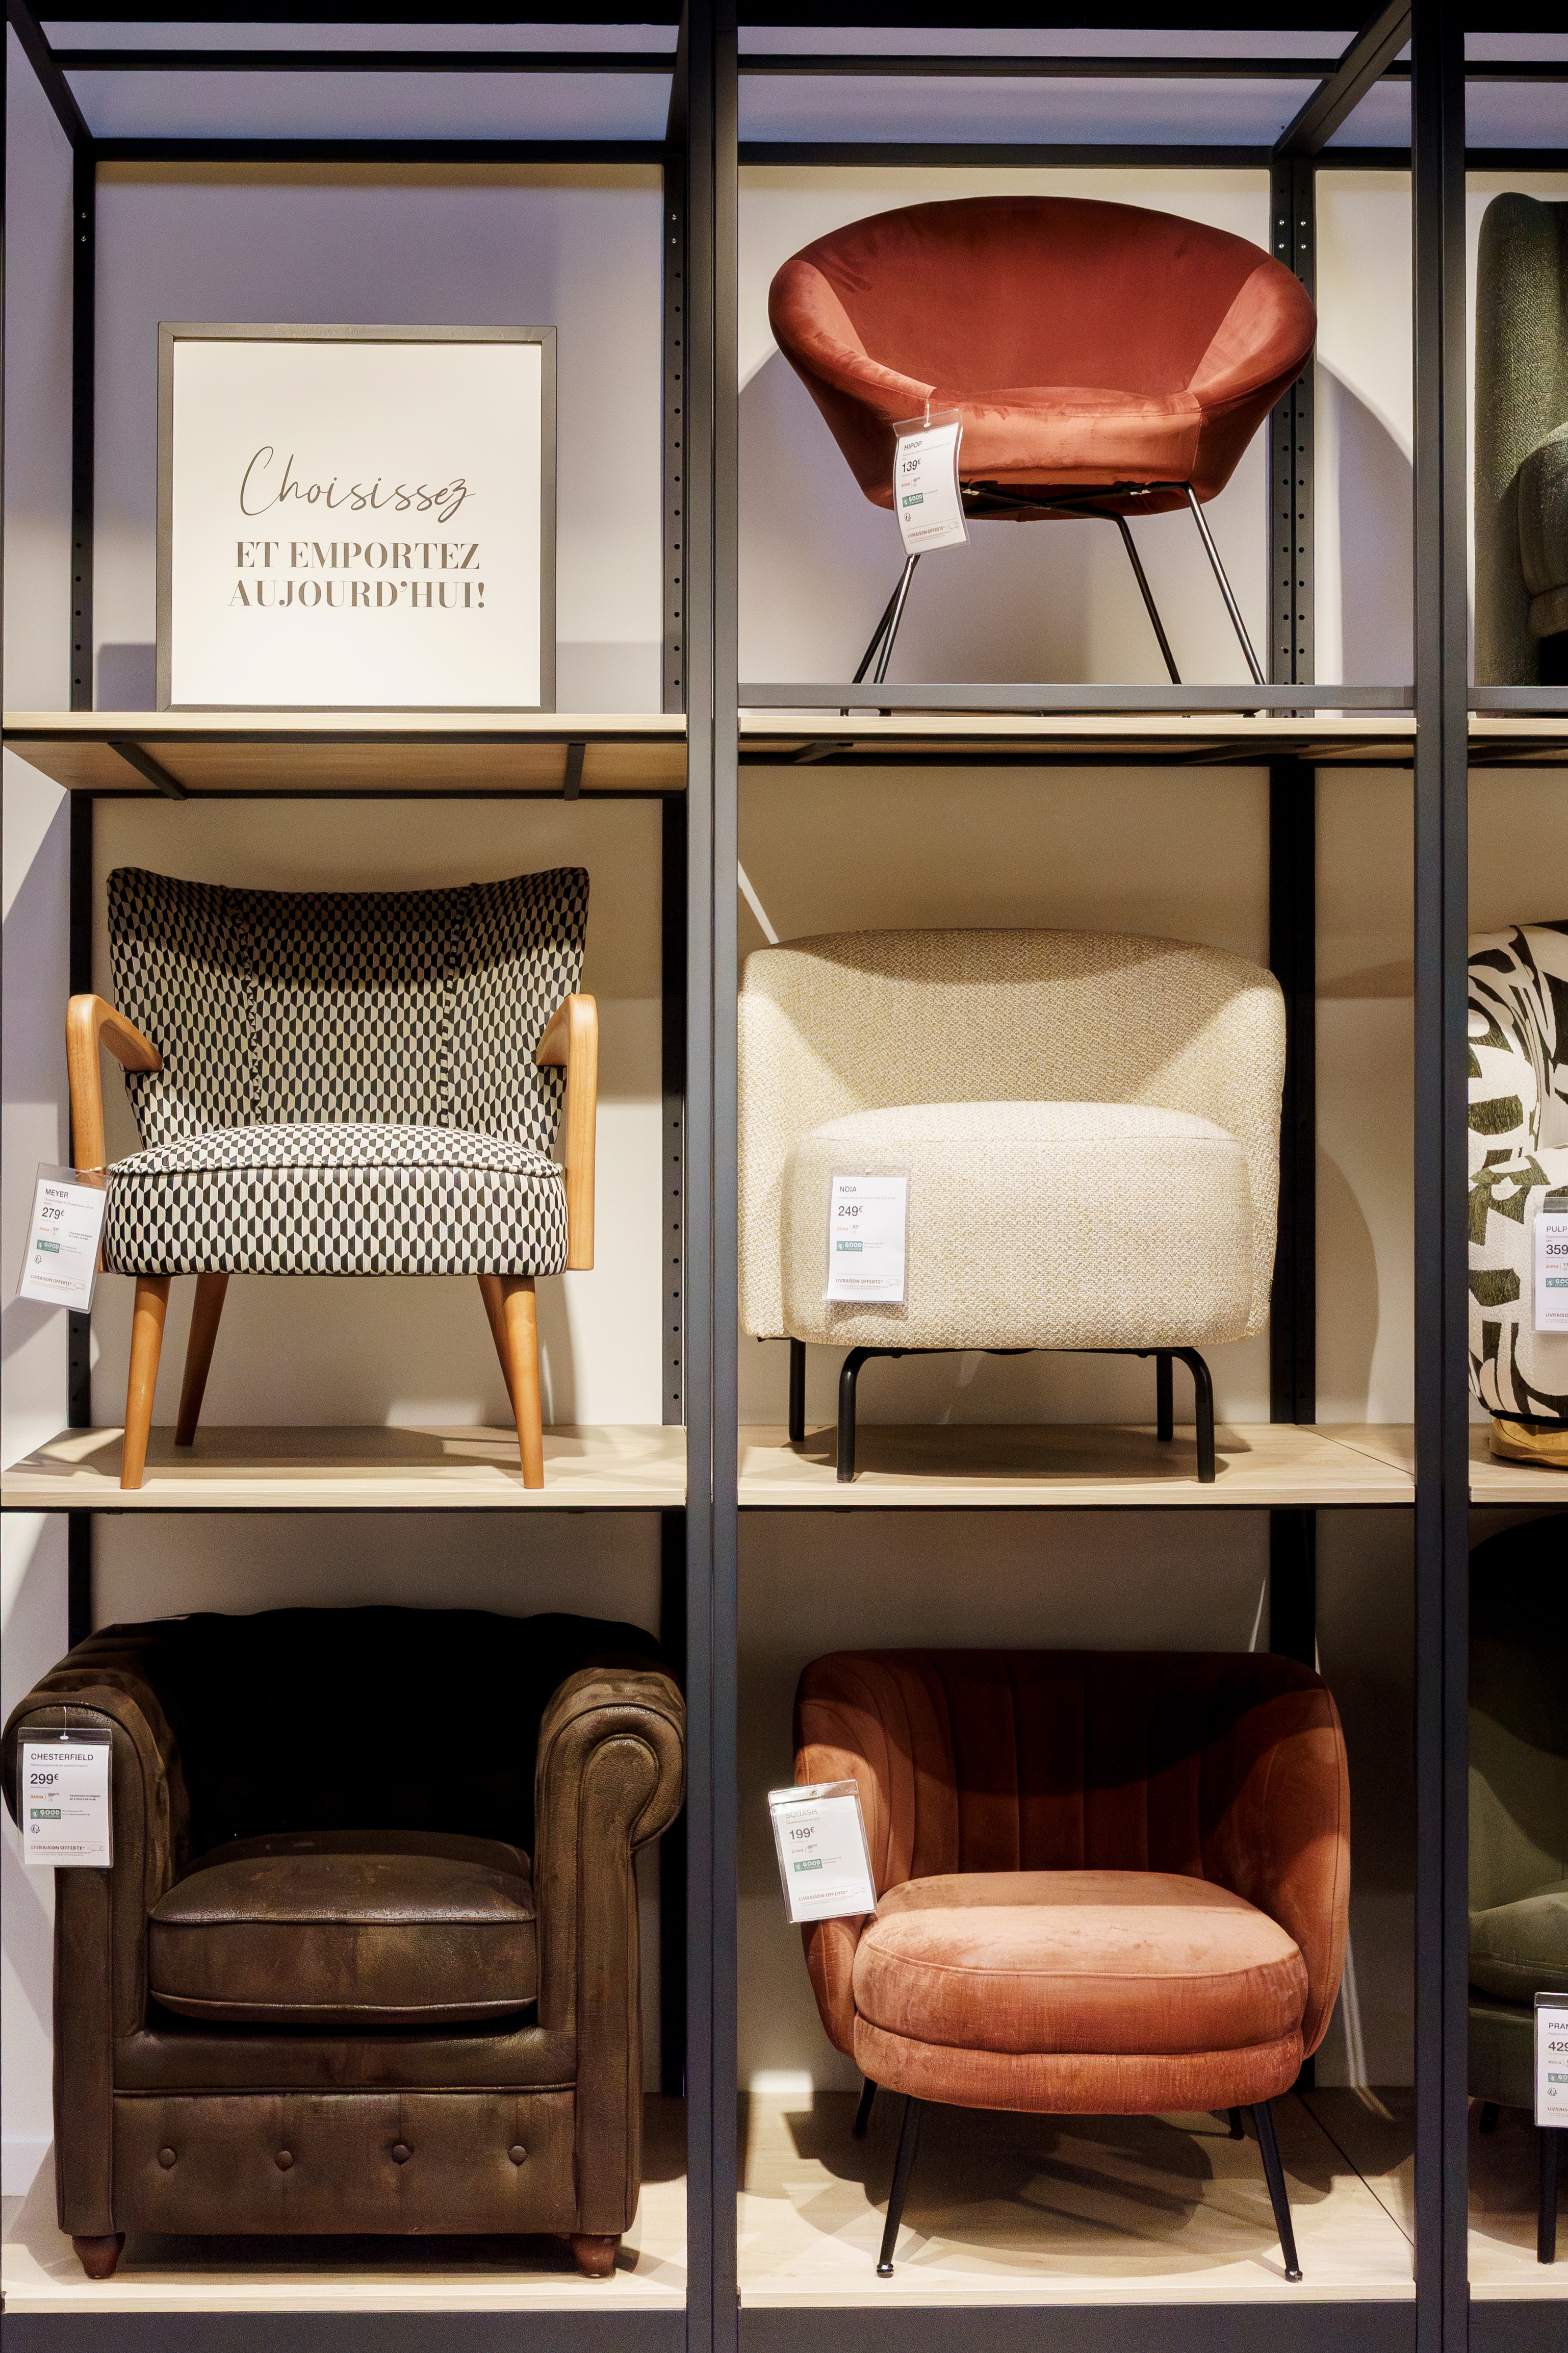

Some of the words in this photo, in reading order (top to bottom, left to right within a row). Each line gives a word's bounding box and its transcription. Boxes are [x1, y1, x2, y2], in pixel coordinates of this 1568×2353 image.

[904, 441, 922, 450] HIPOP
[902, 458, 921, 473] 139€
[240, 446, 476, 523] Choisissez
[908, 530, 928, 538] LIVRAISON
[234, 541, 278, 568] ET
[288, 542, 480, 569] EMPORTEZ
[227, 579, 484, 609] AUJOURD'HUI!
[45, 1188, 68, 1198] MEYER
[42, 1207, 65, 1220] 279€
[838, 1206, 863, 1217] 249€
[1546, 1244, 1568, 1255] 359
[31, 1274, 53, 1282] LIVRAISON
[30, 1773, 59, 1785] 299€
[785, 1809, 818, 1819] SQUASH
[789, 1827, 815, 1840] 199€
[799, 1893, 825, 1902] LIVRAISON
